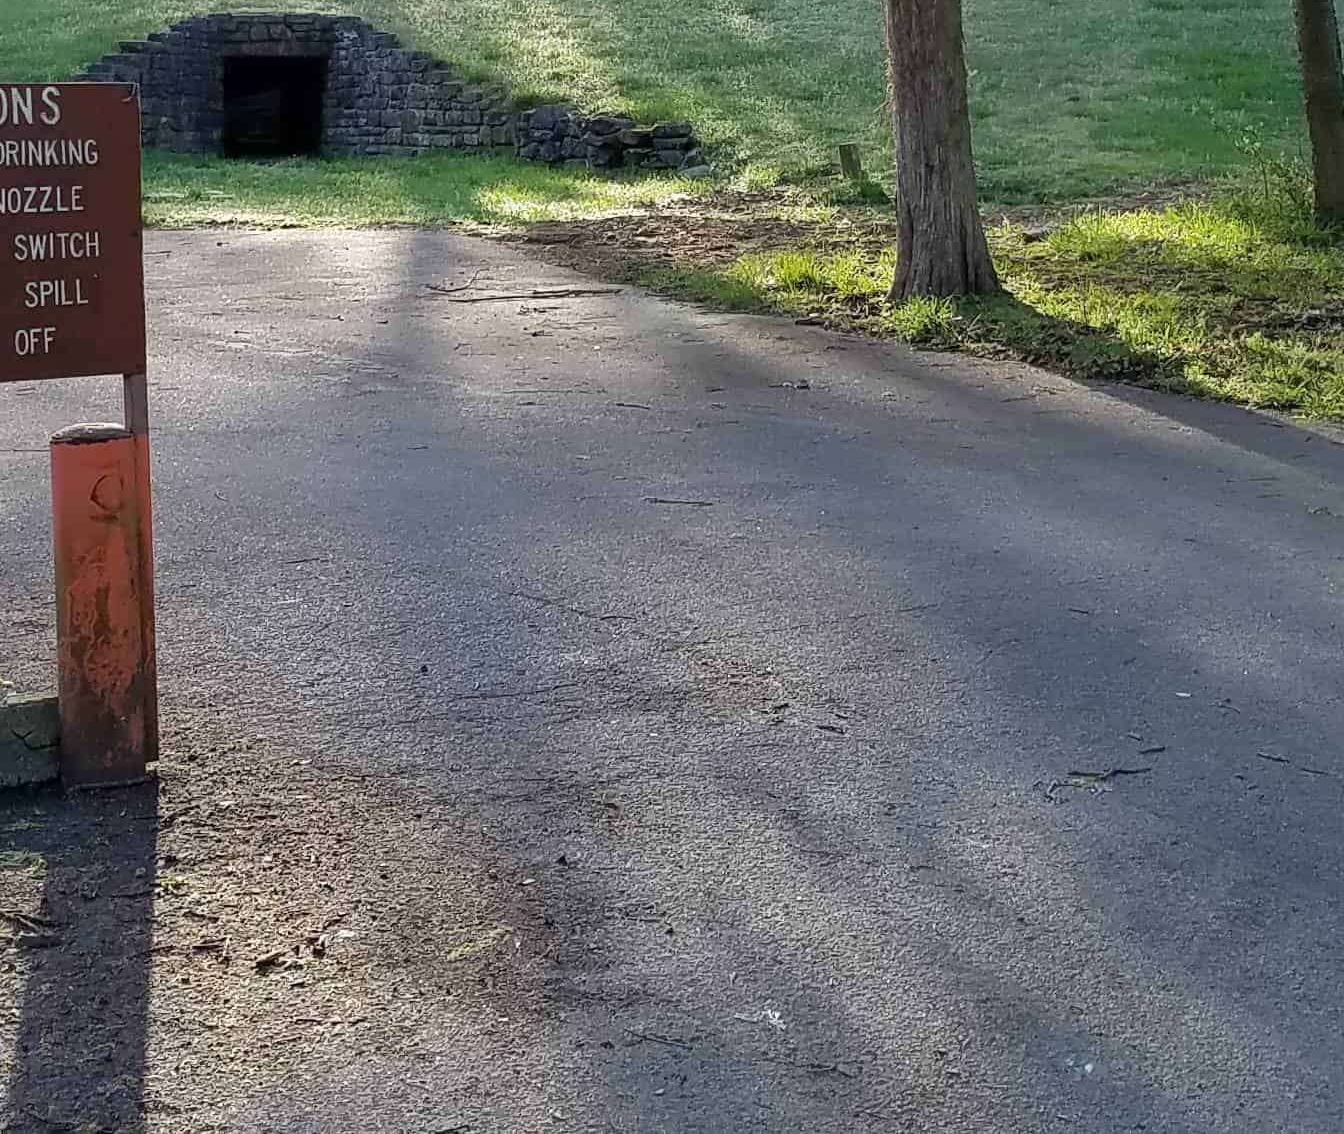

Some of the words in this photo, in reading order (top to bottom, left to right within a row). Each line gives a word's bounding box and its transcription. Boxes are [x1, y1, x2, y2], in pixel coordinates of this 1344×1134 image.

[15, 232, 99, 260] SWITCH
[25, 279, 88, 307] SPILL
[15, 327, 55, 355] OFF
